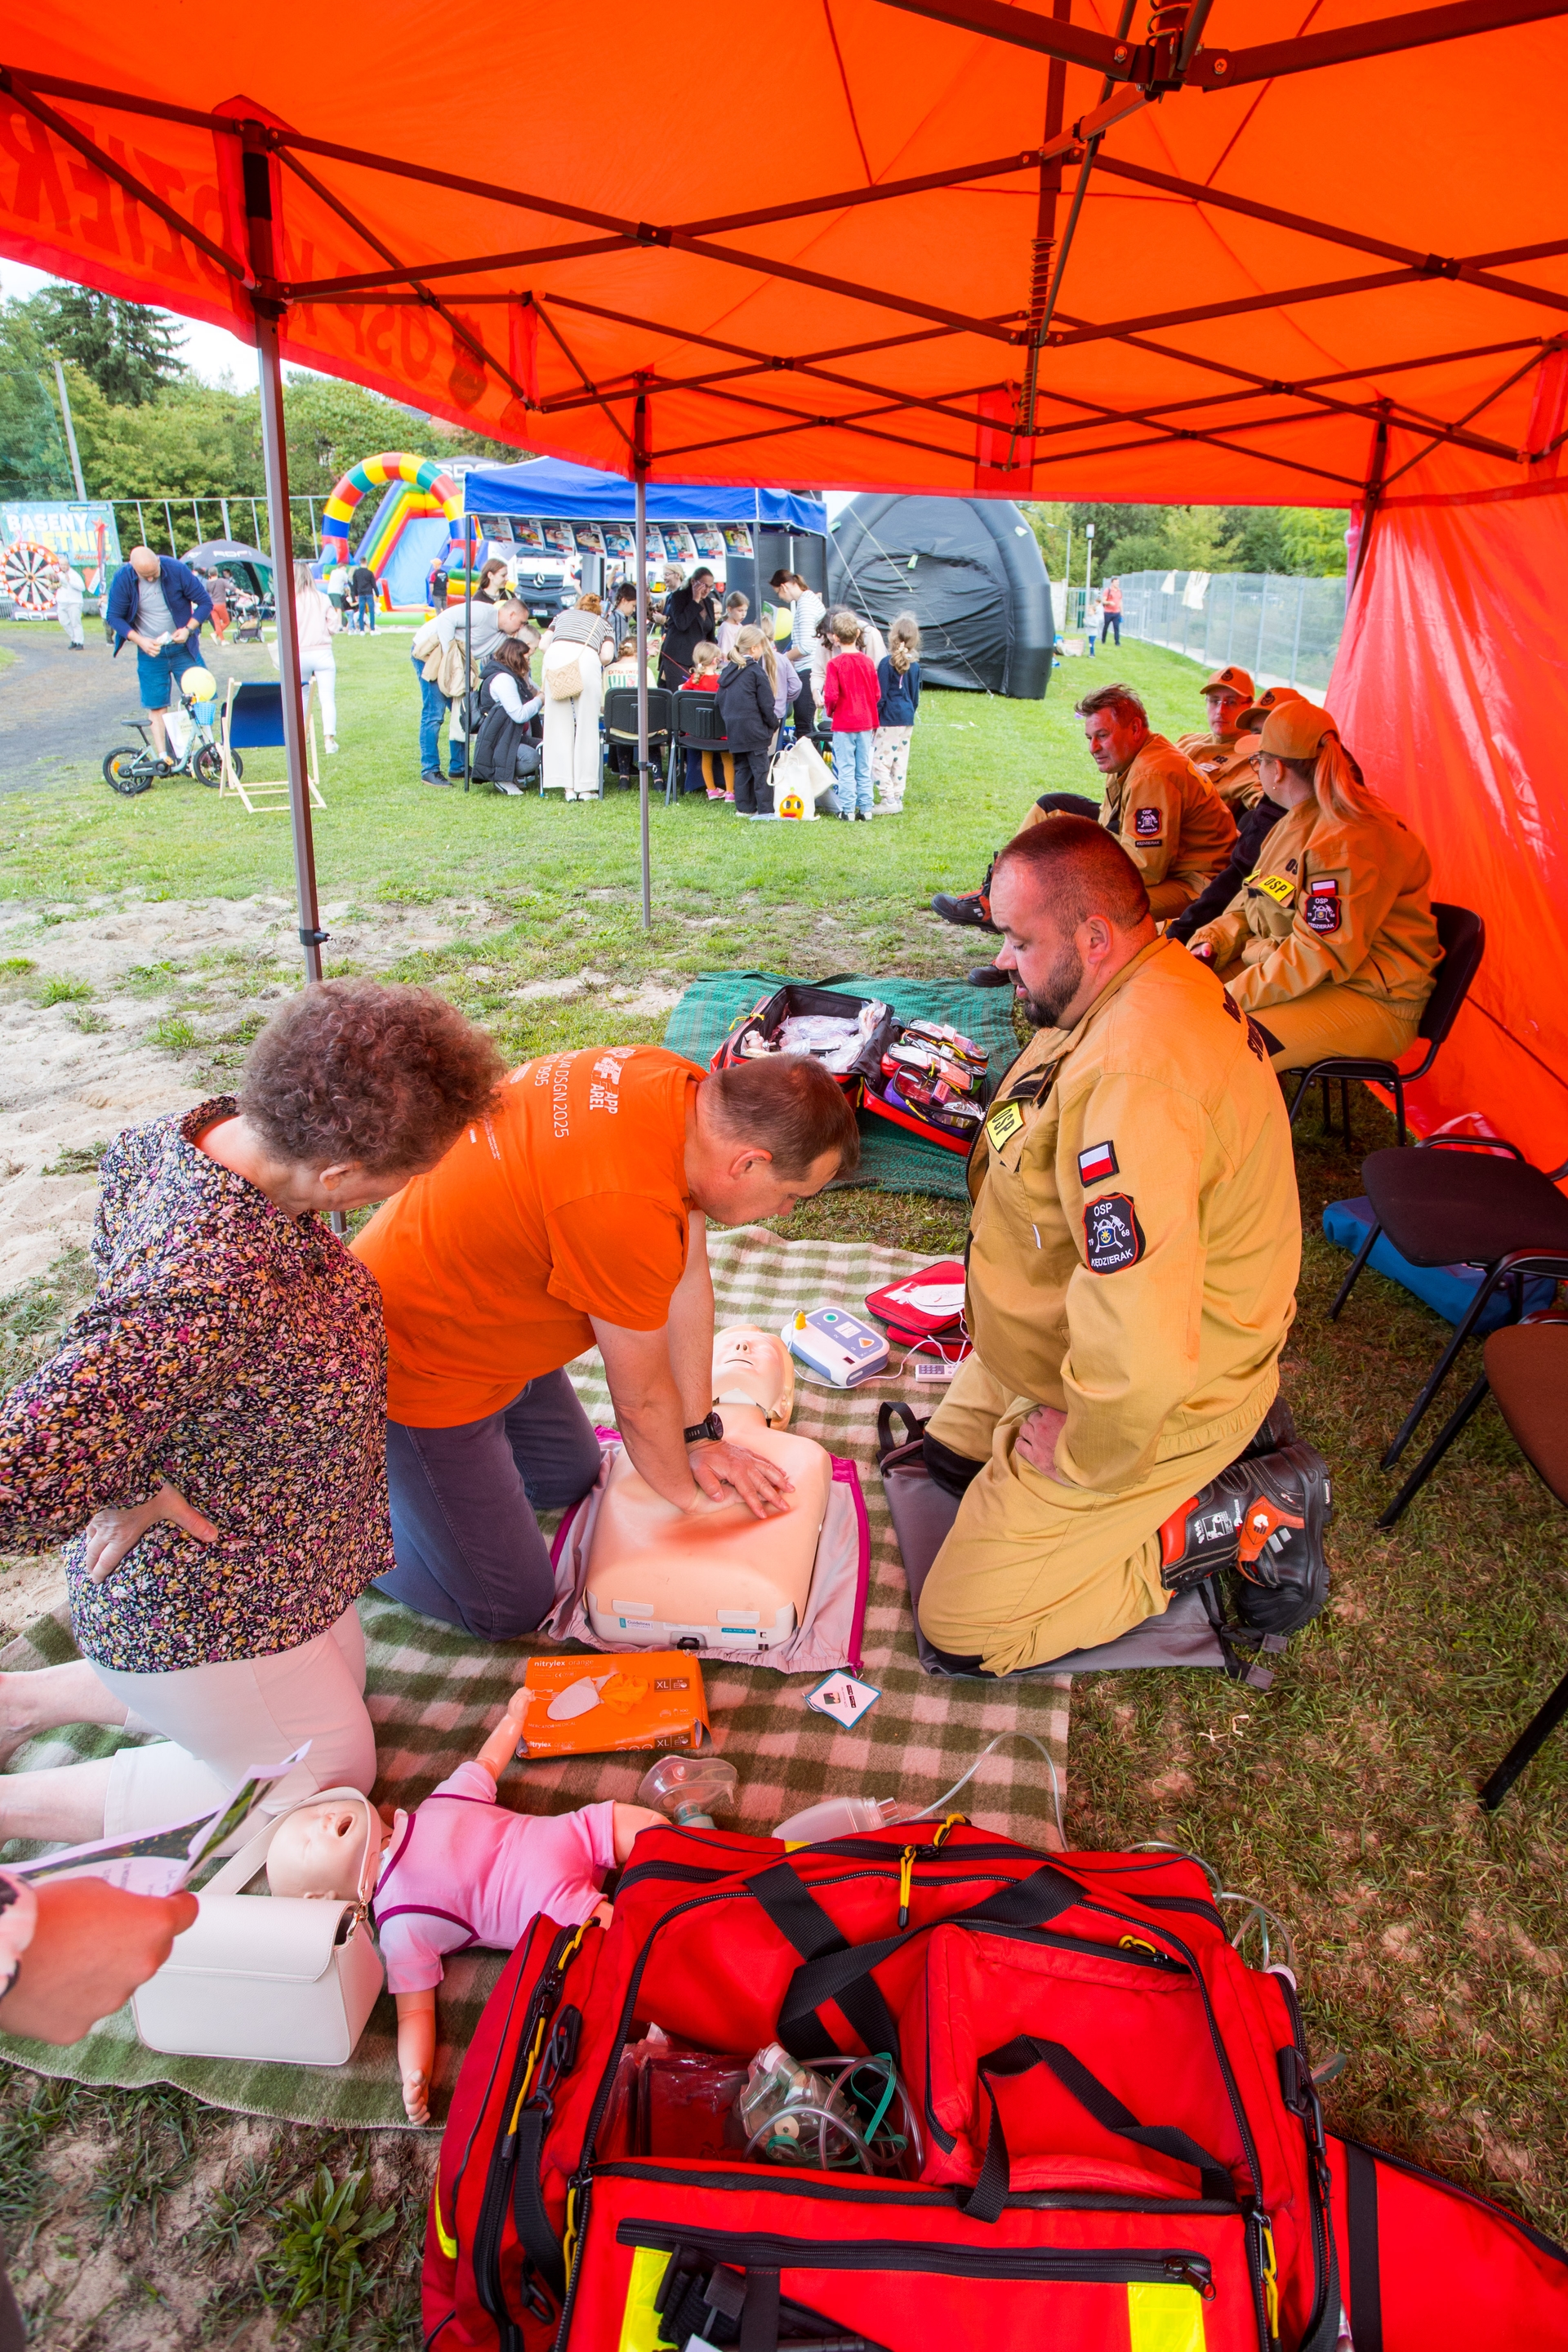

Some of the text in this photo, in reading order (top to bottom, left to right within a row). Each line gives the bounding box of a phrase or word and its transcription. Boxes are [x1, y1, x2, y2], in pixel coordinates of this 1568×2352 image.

[6, 513, 87, 532] BASENY
[1213, 755, 1228, 764] OSP
[1263, 878, 1288, 893] OSP
[535, 1063, 553, 1087] 1995
[553, 1070, 570, 1102] DSGN
[590, 1083, 606, 1111] AREL
[604, 1091, 618, 1115] APP
[553, 1103, 570, 1138] 2025
[991, 1107, 1015, 1136] OSP
[1094, 1202, 1113, 1217] OSP
[1120, 1228, 1130, 1237] 68
[1088, 1238, 1094, 1246] 19
[1091, 1248, 1134, 1268] KĘDZIERAK
[534, 1659, 566, 1668] nitrylex
[657, 1681, 670, 1689] XL
[526, 1740, 576, 1749] nitrylex orange
[657, 1739, 670, 1748] XL
